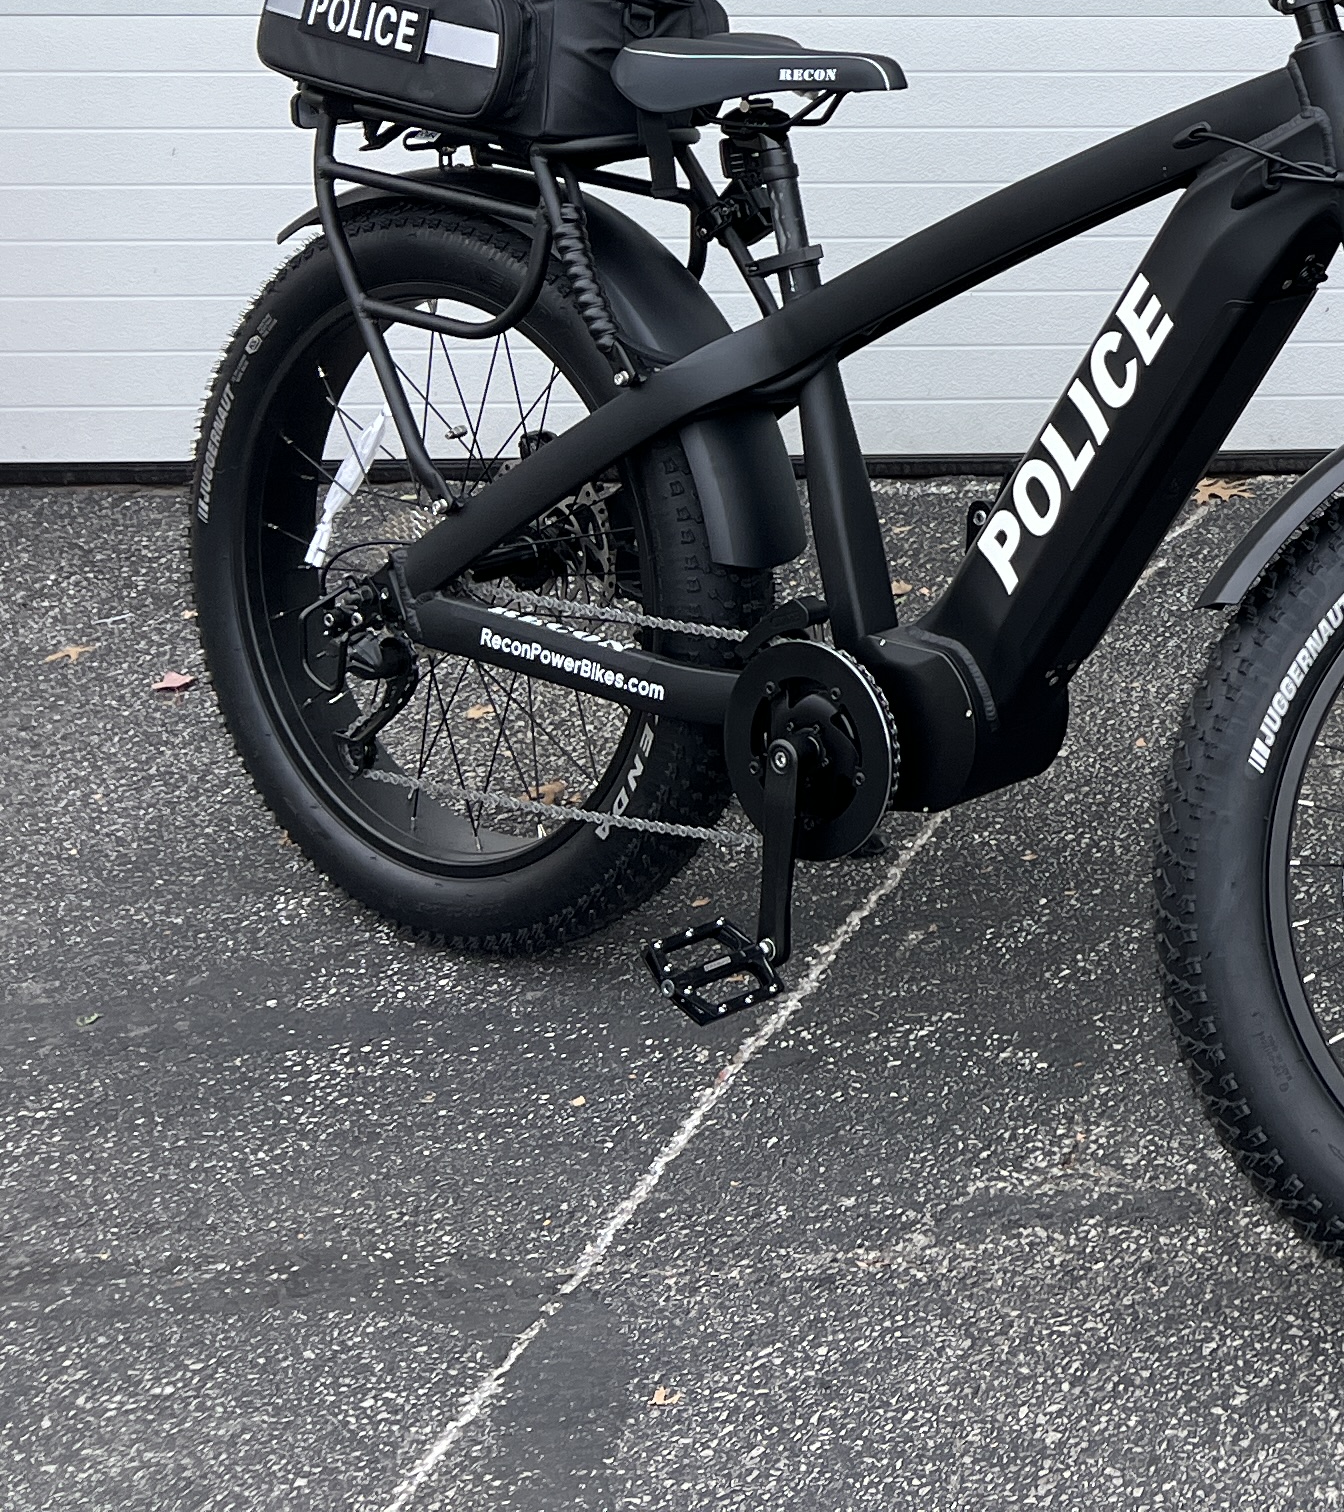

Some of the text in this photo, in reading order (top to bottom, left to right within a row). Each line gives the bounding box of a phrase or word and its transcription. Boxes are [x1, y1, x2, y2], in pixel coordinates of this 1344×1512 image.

[779, 69, 837, 81] RECON
[977, 272, 1174, 596] POLICE
[480, 627, 665, 701] ReconPowerBikes.com
[595, 715, 658, 840] ENDA
